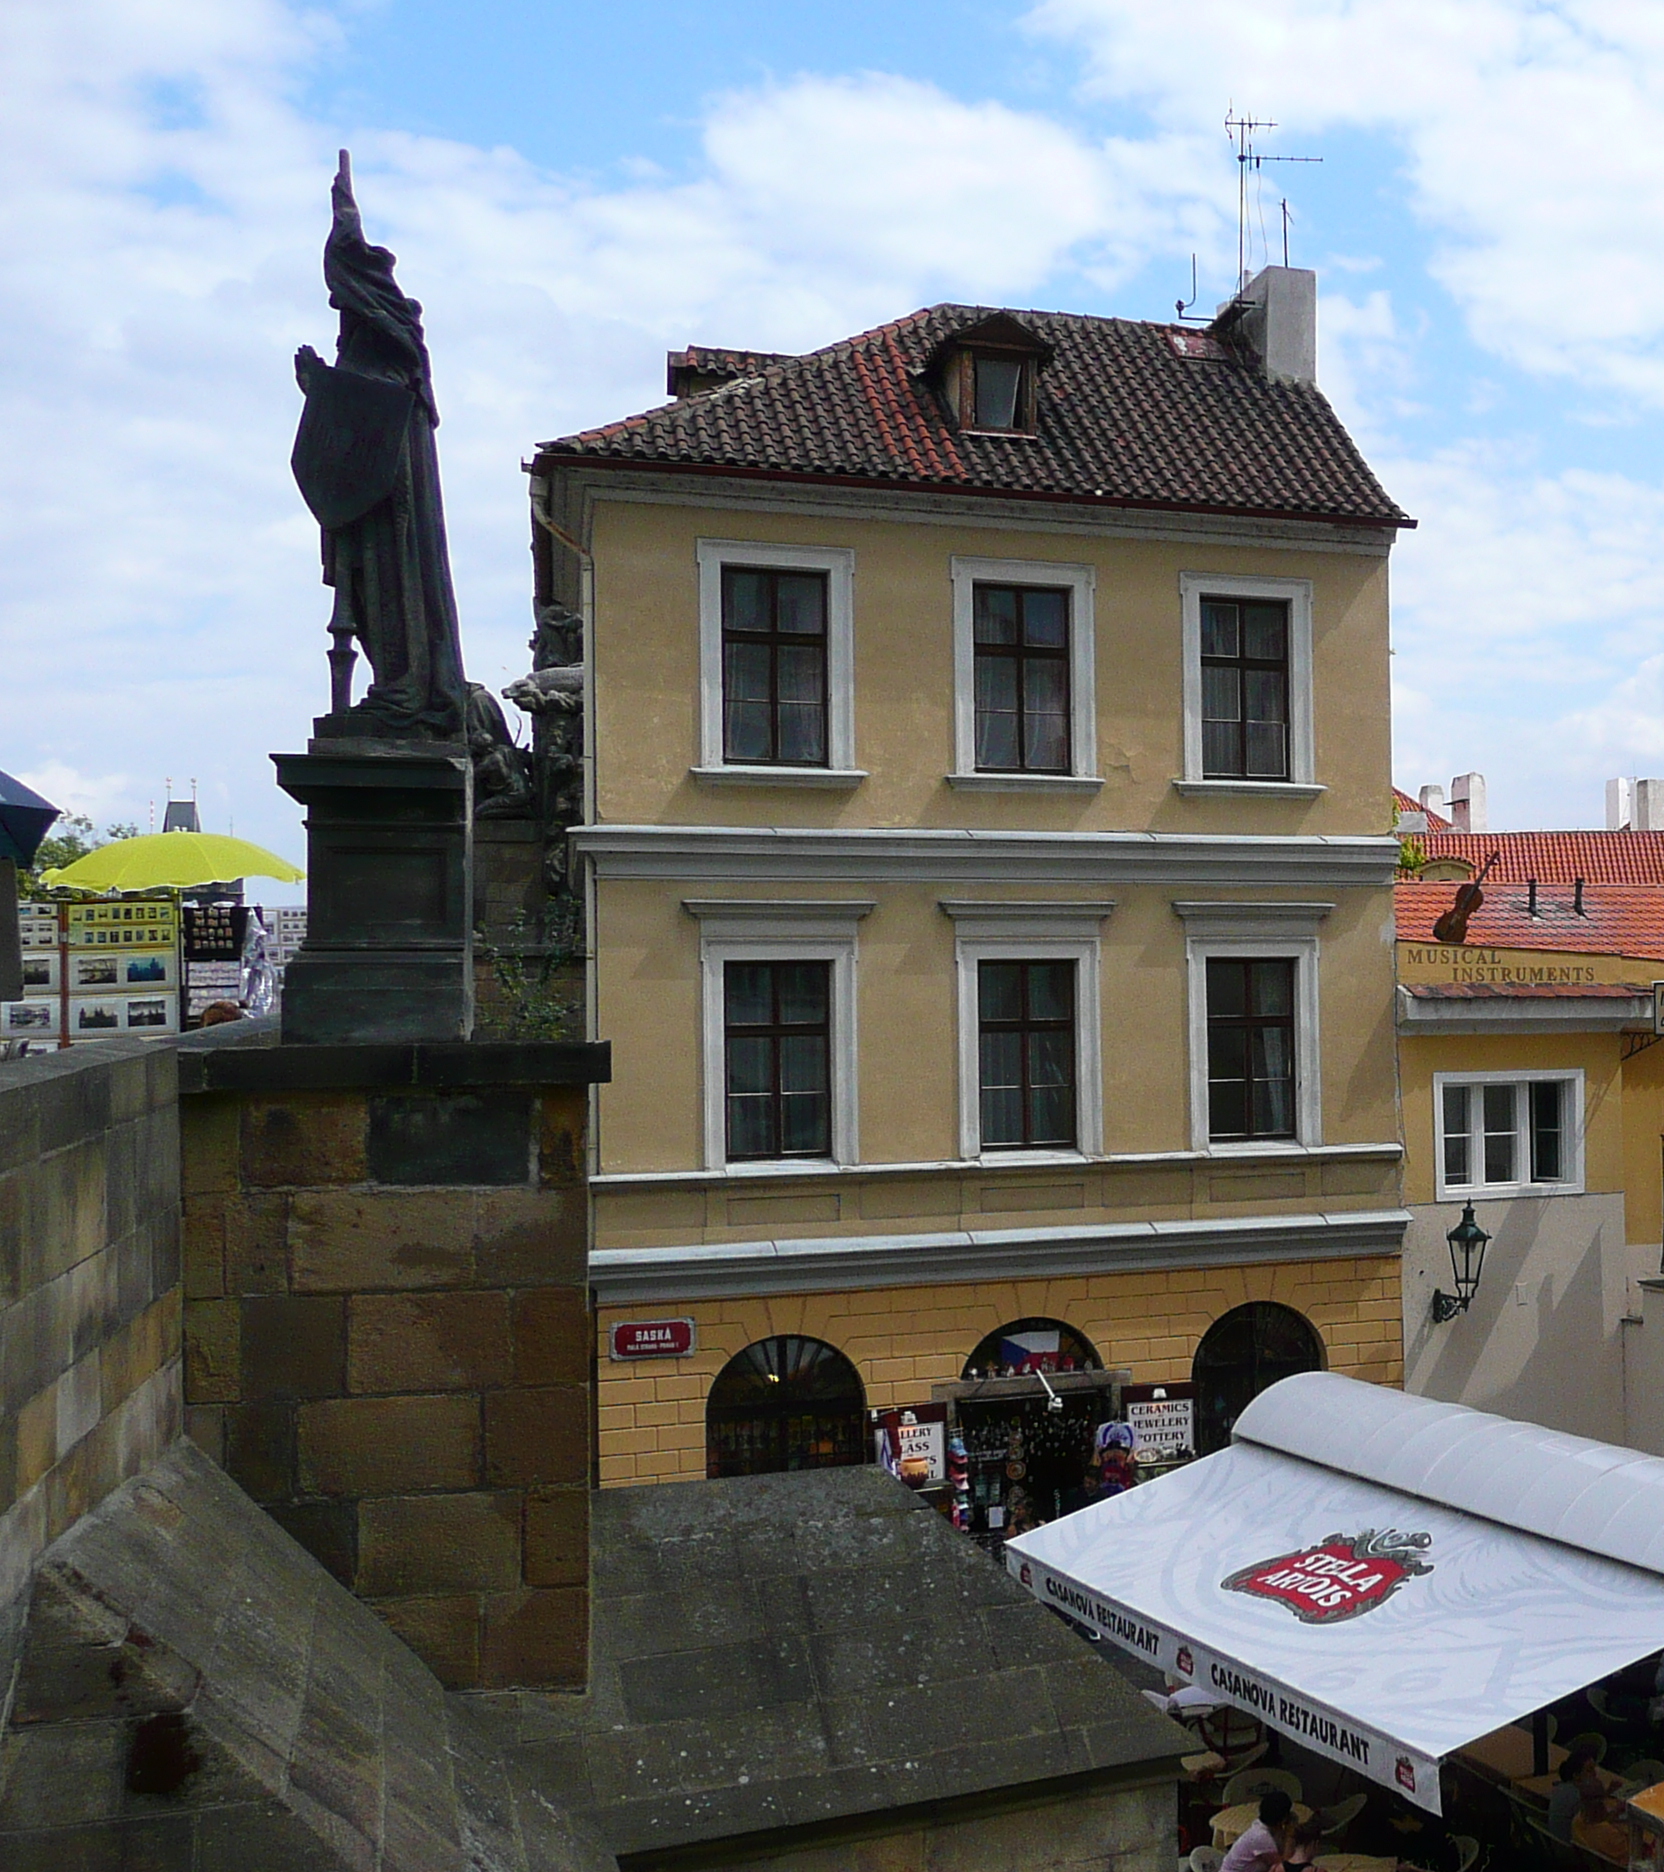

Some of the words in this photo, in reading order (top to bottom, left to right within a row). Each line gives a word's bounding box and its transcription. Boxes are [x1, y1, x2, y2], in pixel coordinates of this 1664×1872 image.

[1407, 949, 1502, 965] MUSICAL
[1453, 966, 1595, 982] INSTRUMENTS
[635, 1326, 672, 1342] SASKÁ
[1130, 1402, 1190, 1416] CERAMICS
[1292, 1553, 1384, 1593] STELLA
[1256, 1569, 1353, 1608] ARTOIS
[1045, 1576, 1095, 1620] CASANOVA
[1096, 1603, 1160, 1656] RESTAURANT
[1210, 1663, 1276, 1718] CASANOVA
[1279, 1697, 1370, 1765] RESTAURANT
